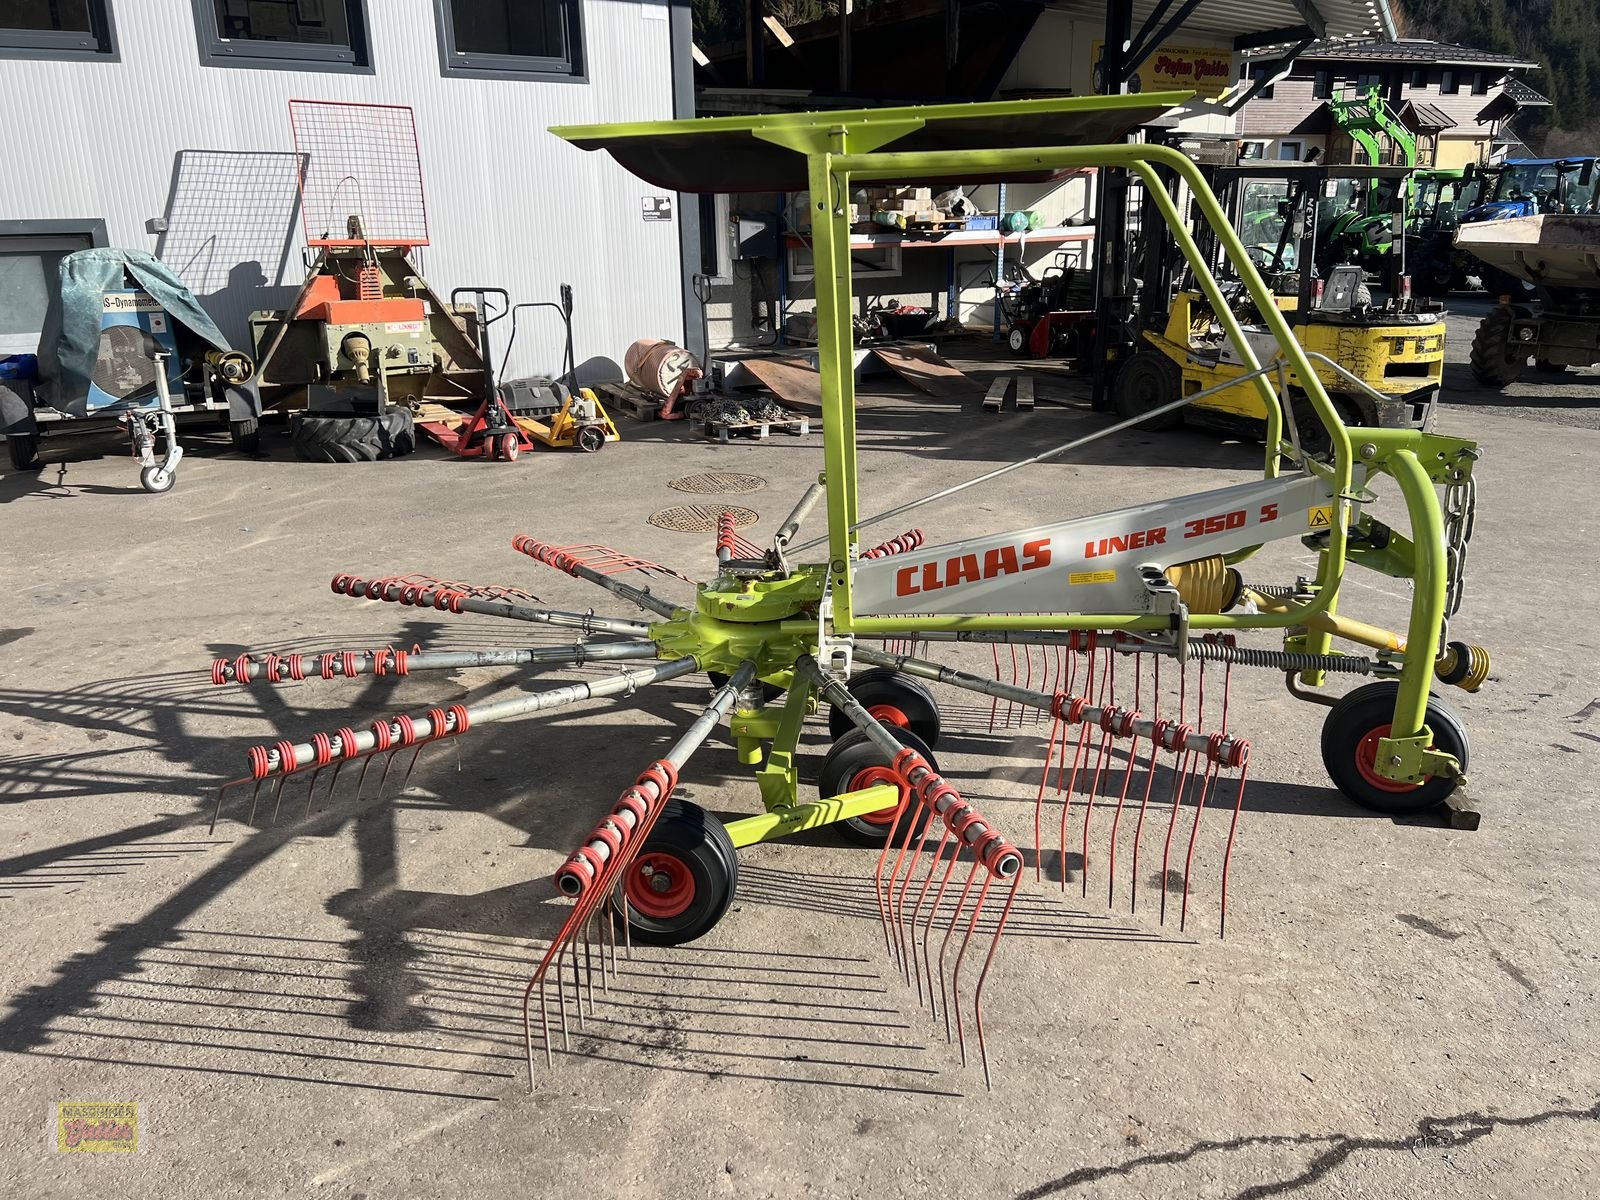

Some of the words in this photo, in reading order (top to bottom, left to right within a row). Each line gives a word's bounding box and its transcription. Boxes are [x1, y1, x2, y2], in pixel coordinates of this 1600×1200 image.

[1154, 55, 1193, 78] Stefan
[1305, 198, 1314, 227] NEW
[897, 538, 1051, 596] CLAAS
[1085, 527, 1166, 558] LINER
[1184, 510, 1247, 538] 350
[1259, 503, 1278, 523] S
